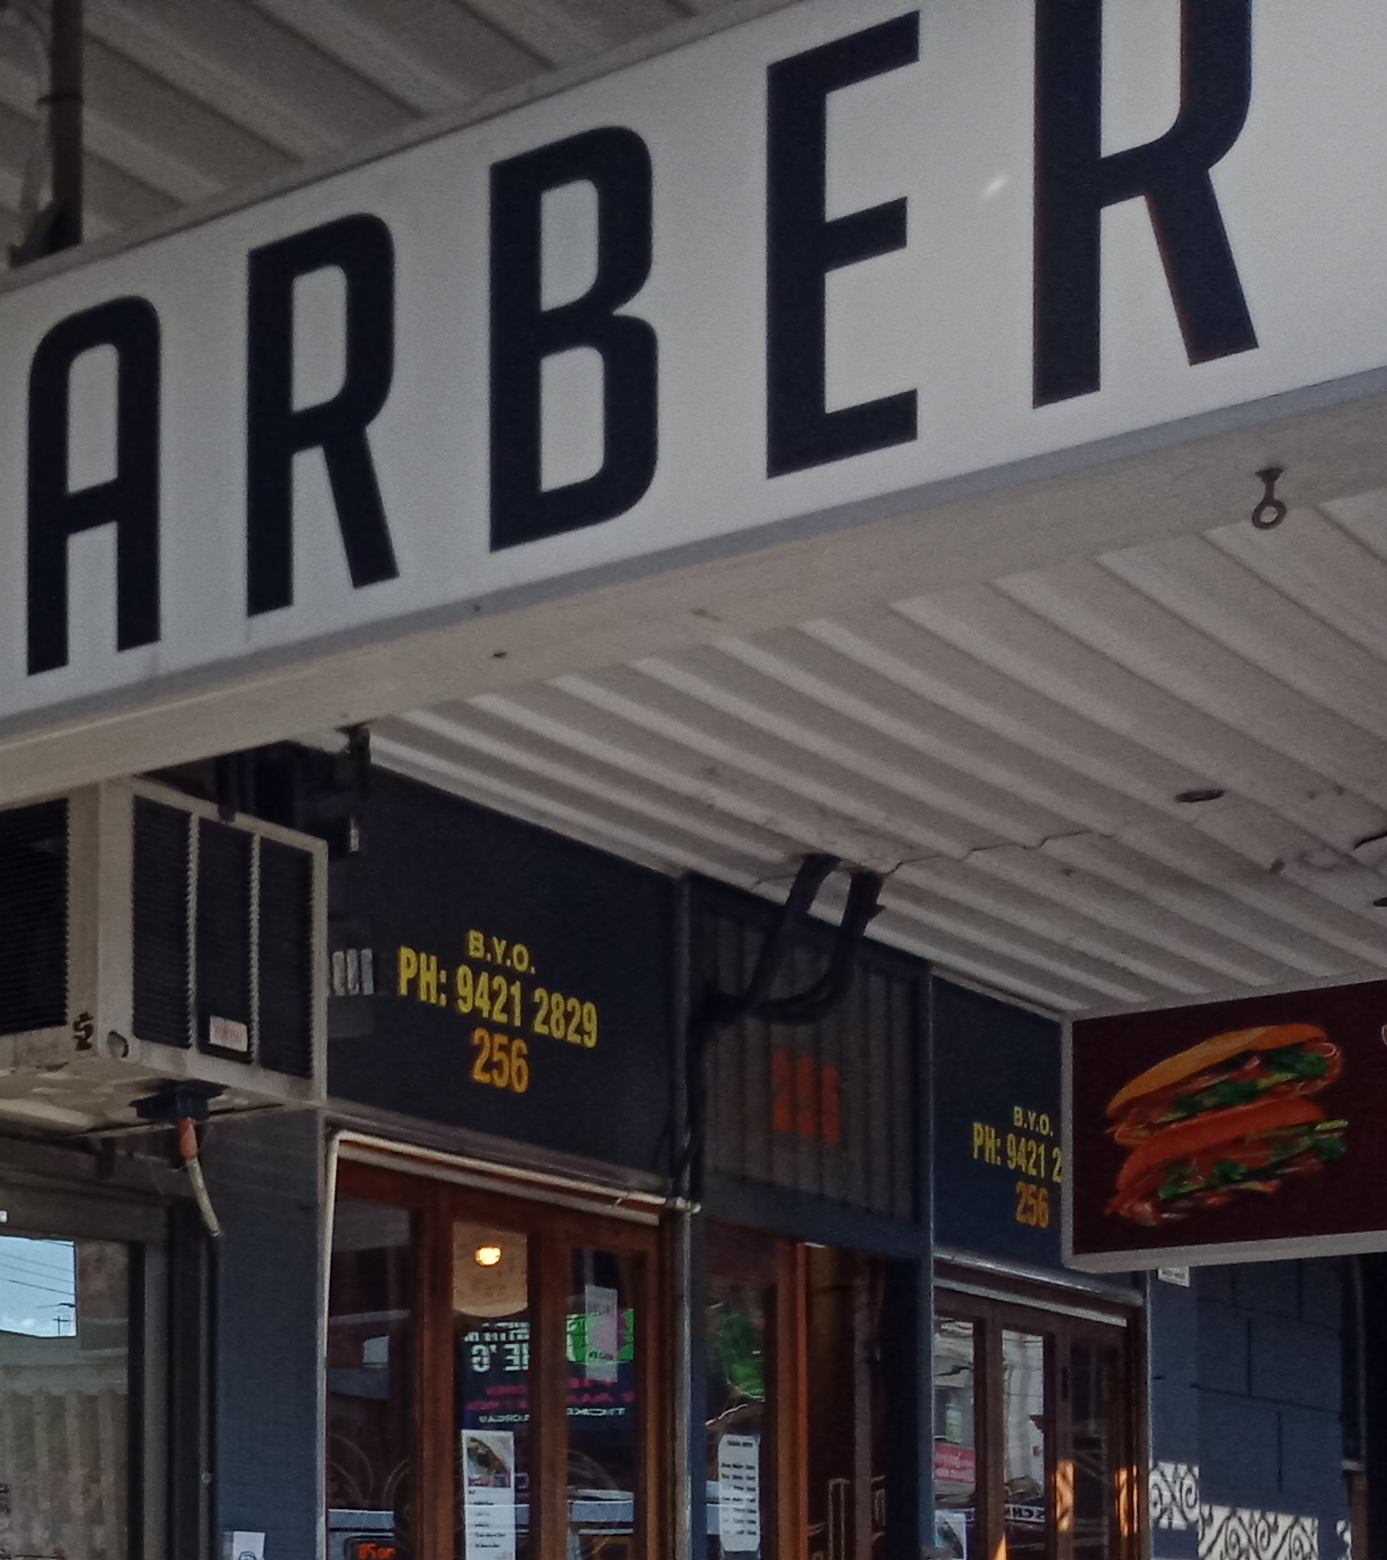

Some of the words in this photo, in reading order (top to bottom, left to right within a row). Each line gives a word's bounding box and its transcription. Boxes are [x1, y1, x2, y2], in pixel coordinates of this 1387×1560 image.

[468, 929, 536, 975] B.Y.O.
[397, 946, 447, 1008] PH:
[455, 964, 522, 1027] 9421
[533, 988, 599, 1050] 2829
[472, 1028, 530, 1094] 256
[1013, 1105, 1053, 1137] B.Y.O.
[973, 1121, 1001, 1166] PH:
[1007, 1132, 1045, 1178] 9421
[1015, 1181, 1049, 1228] 256
